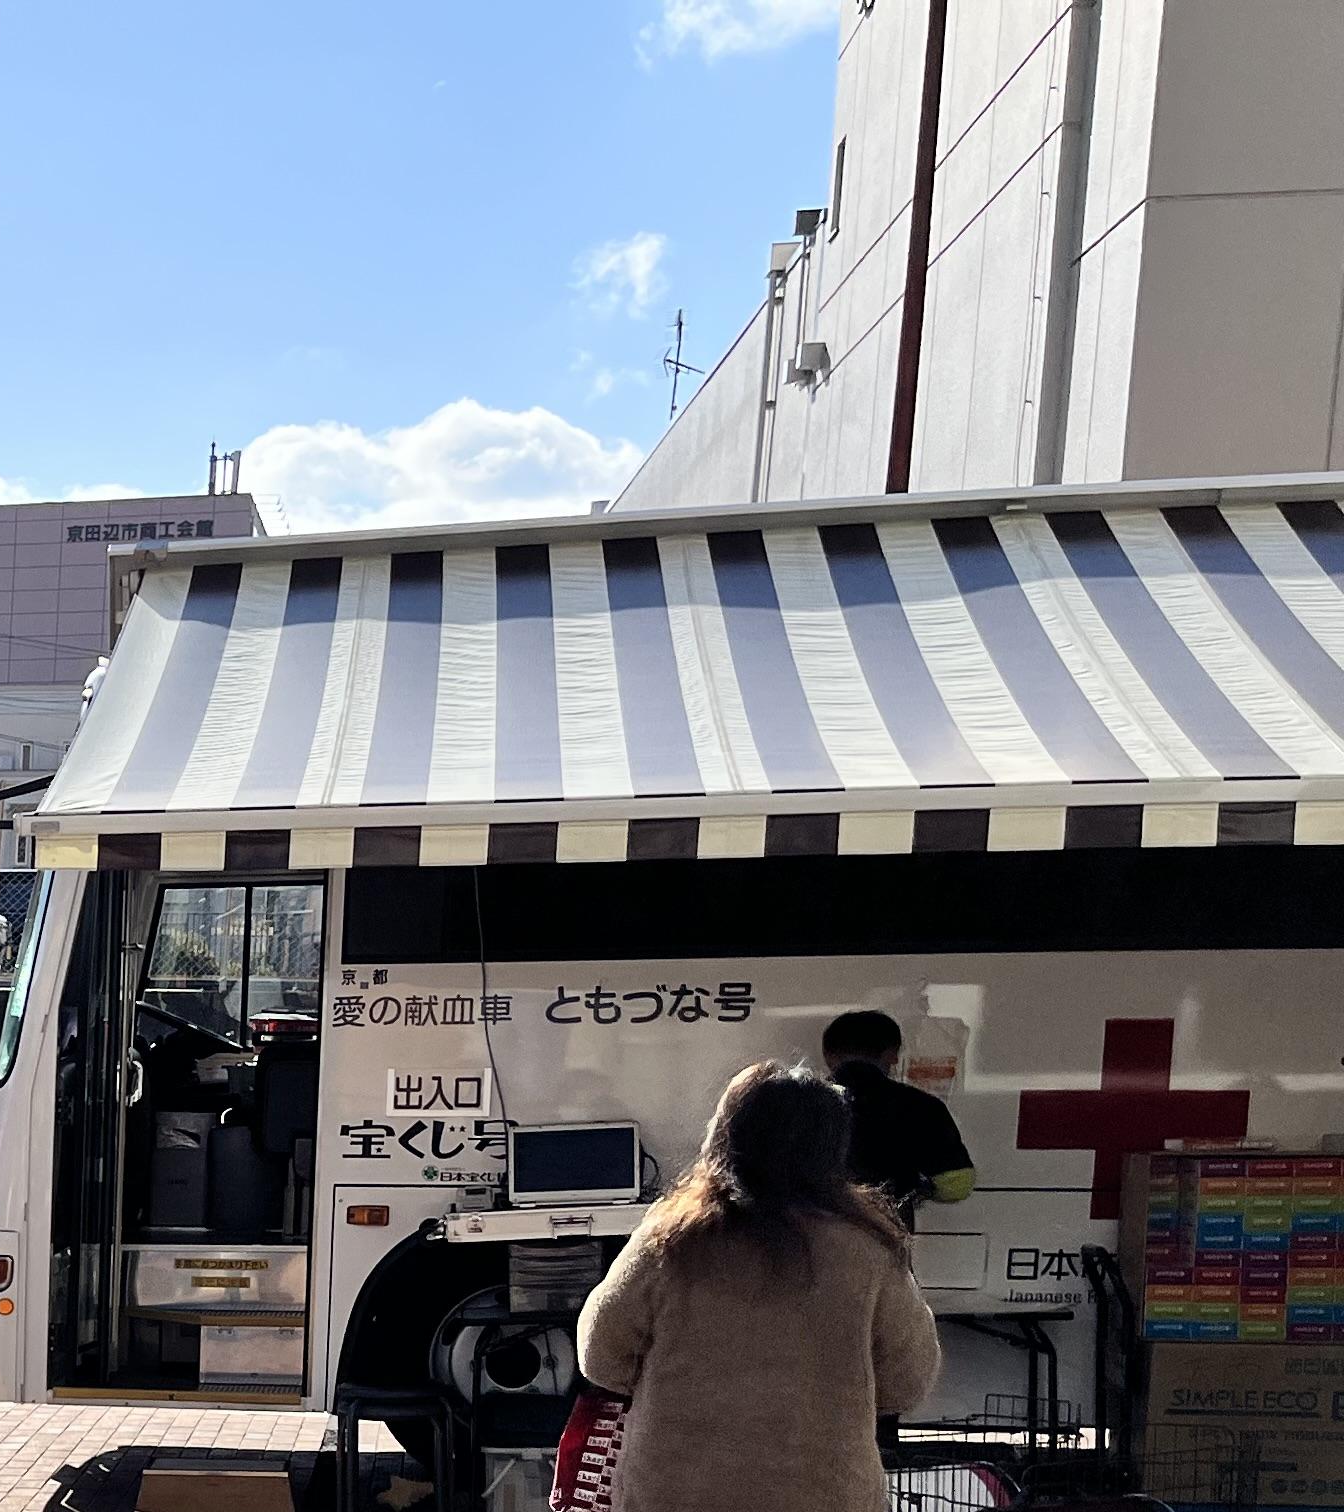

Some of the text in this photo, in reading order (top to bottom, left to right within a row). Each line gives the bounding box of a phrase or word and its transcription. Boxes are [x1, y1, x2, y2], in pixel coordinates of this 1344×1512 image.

[67, 519, 214, 543] 京田辺市商工会館
[332, 982, 756, 1028] 愛の献血車 ともづな号
[393, 1074, 482, 1111] 出入口
[1263, 1389, 1319, 1410] ECO
